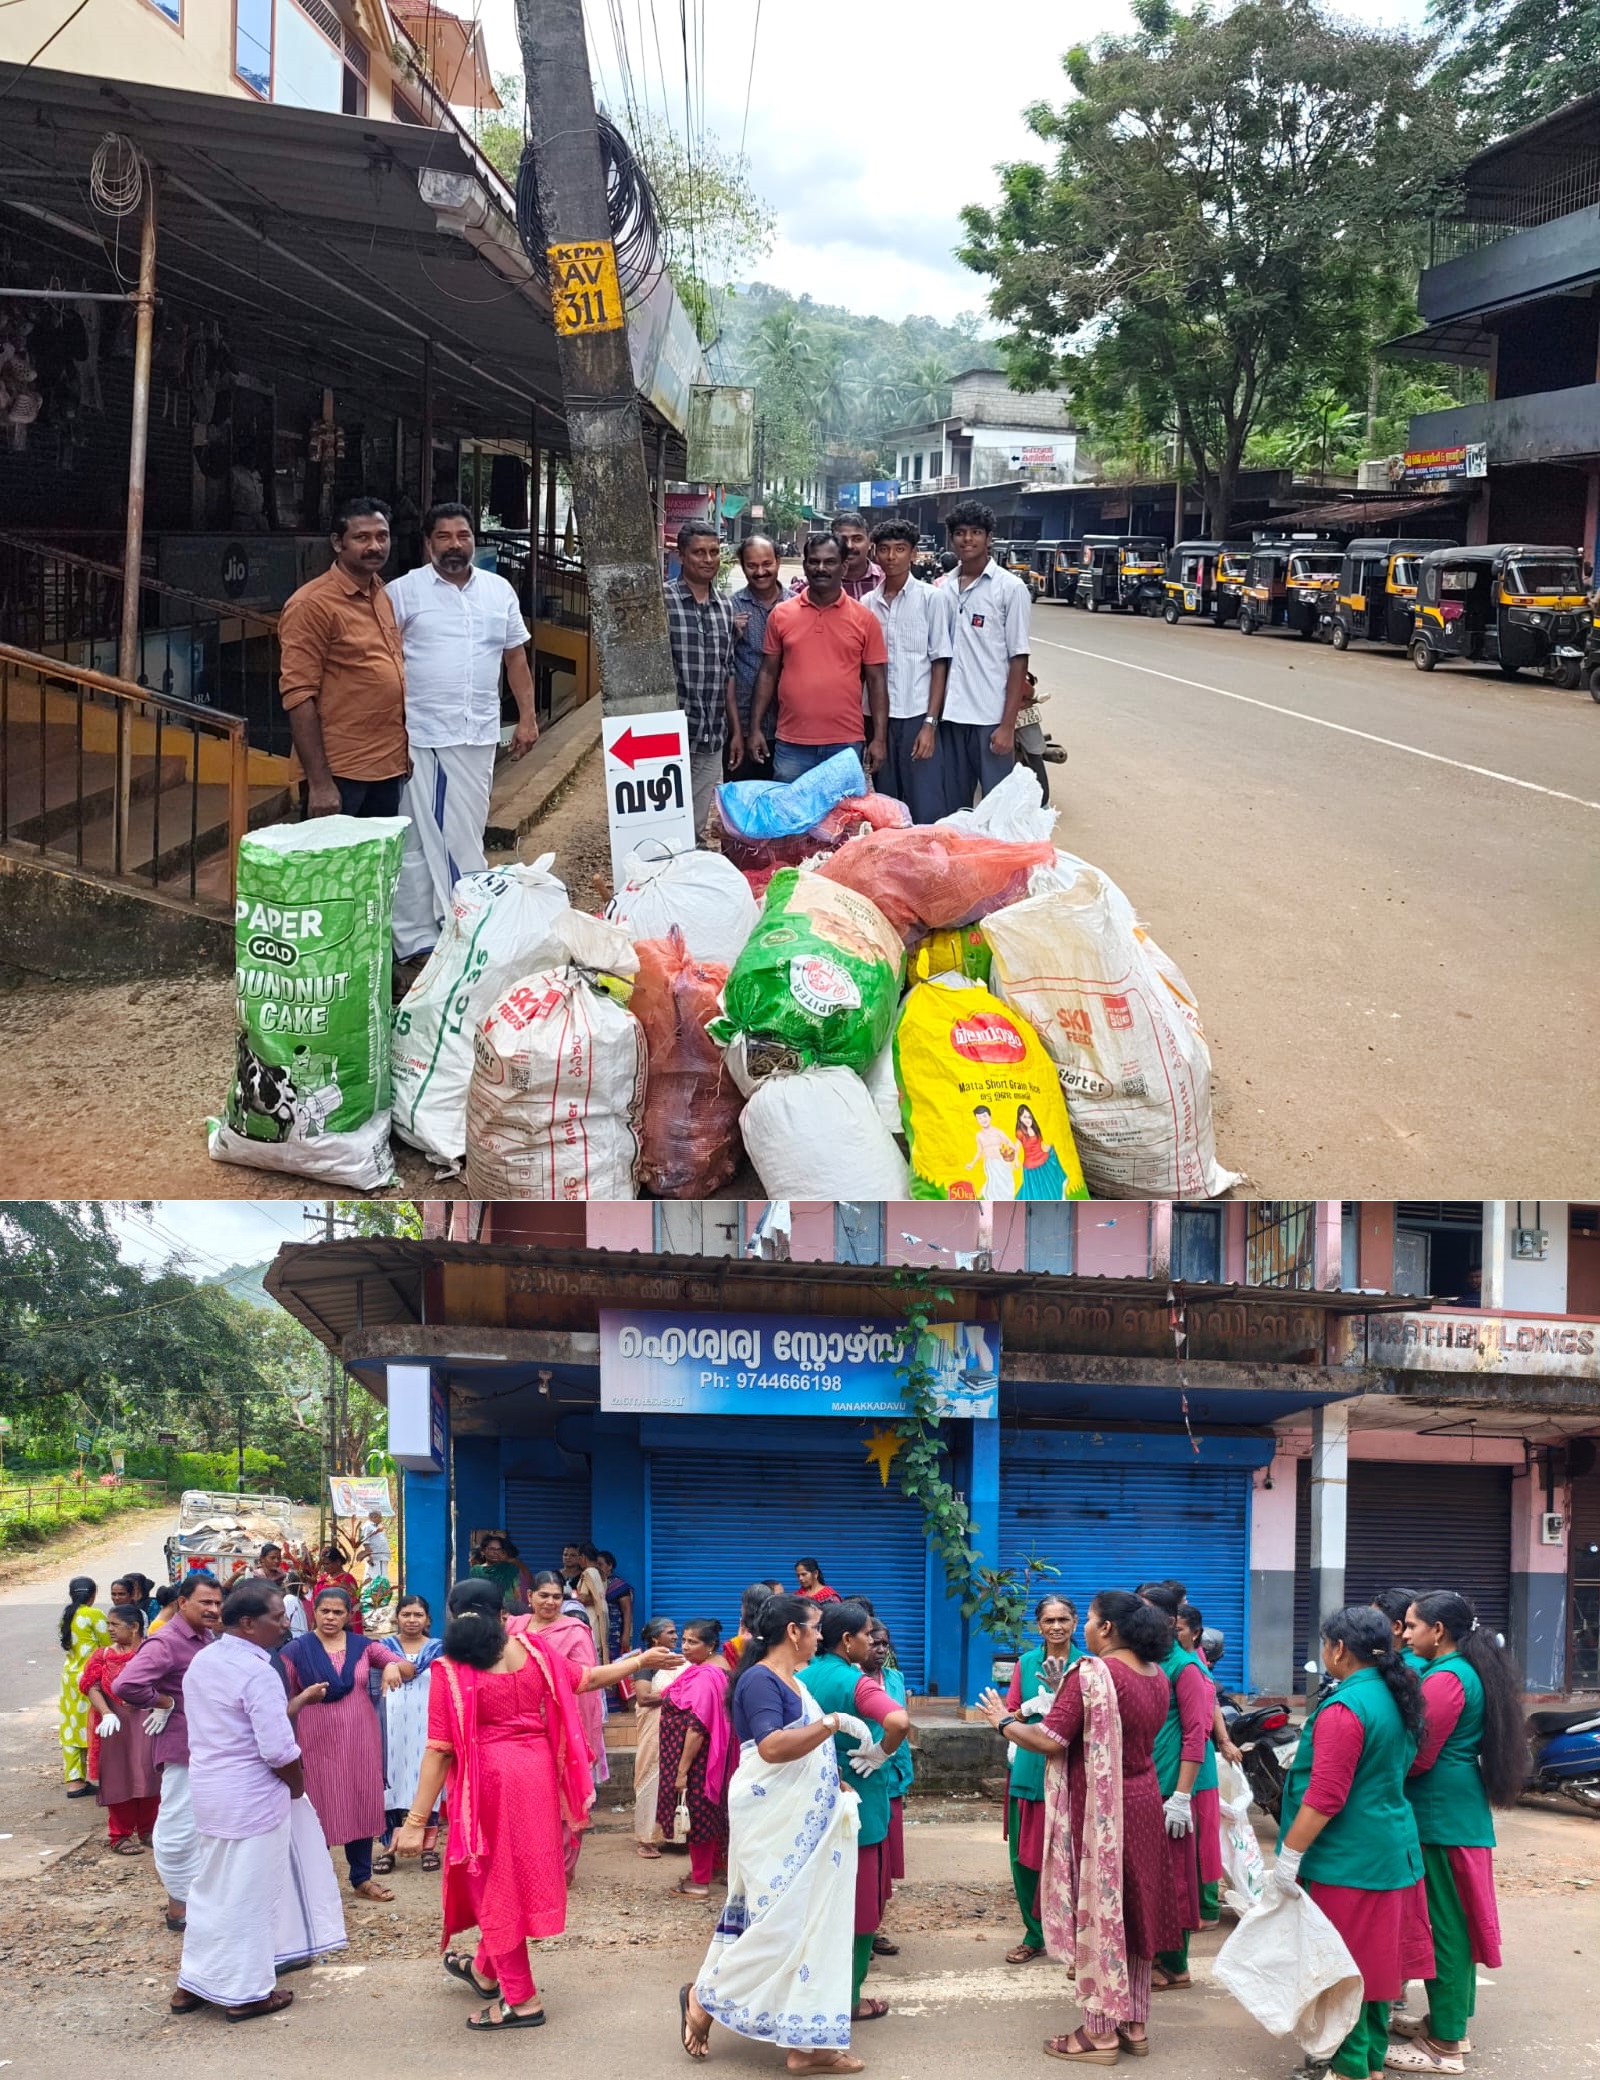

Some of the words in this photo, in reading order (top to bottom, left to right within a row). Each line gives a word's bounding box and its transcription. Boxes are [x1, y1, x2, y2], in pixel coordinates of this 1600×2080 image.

[557, 246, 604, 260] KPM
[564, 261, 603, 288] AV
[564, 289, 608, 327] 311
[224, 555, 246, 581] Jio
[615, 763, 684, 814] വഴി
[236, 900, 324, 939] PAPER
[252, 941, 292, 962] GOLD
[236, 967, 351, 1005] OUNDNUT
[259, 1002, 329, 1035] CAKE
[958, 1082, 984, 1093] Matta
[985, 1079, 1008, 1090] Short
[1009, 1080, 1027, 1091] Grain
[618, 1326, 761, 1369] ഐശ്വര്യ
[700, 1371, 730, 1388] Ph:
[736, 1372, 842, 1391] 9744666198
[831, 1402, 906, 1411] MANAKKADAVU
